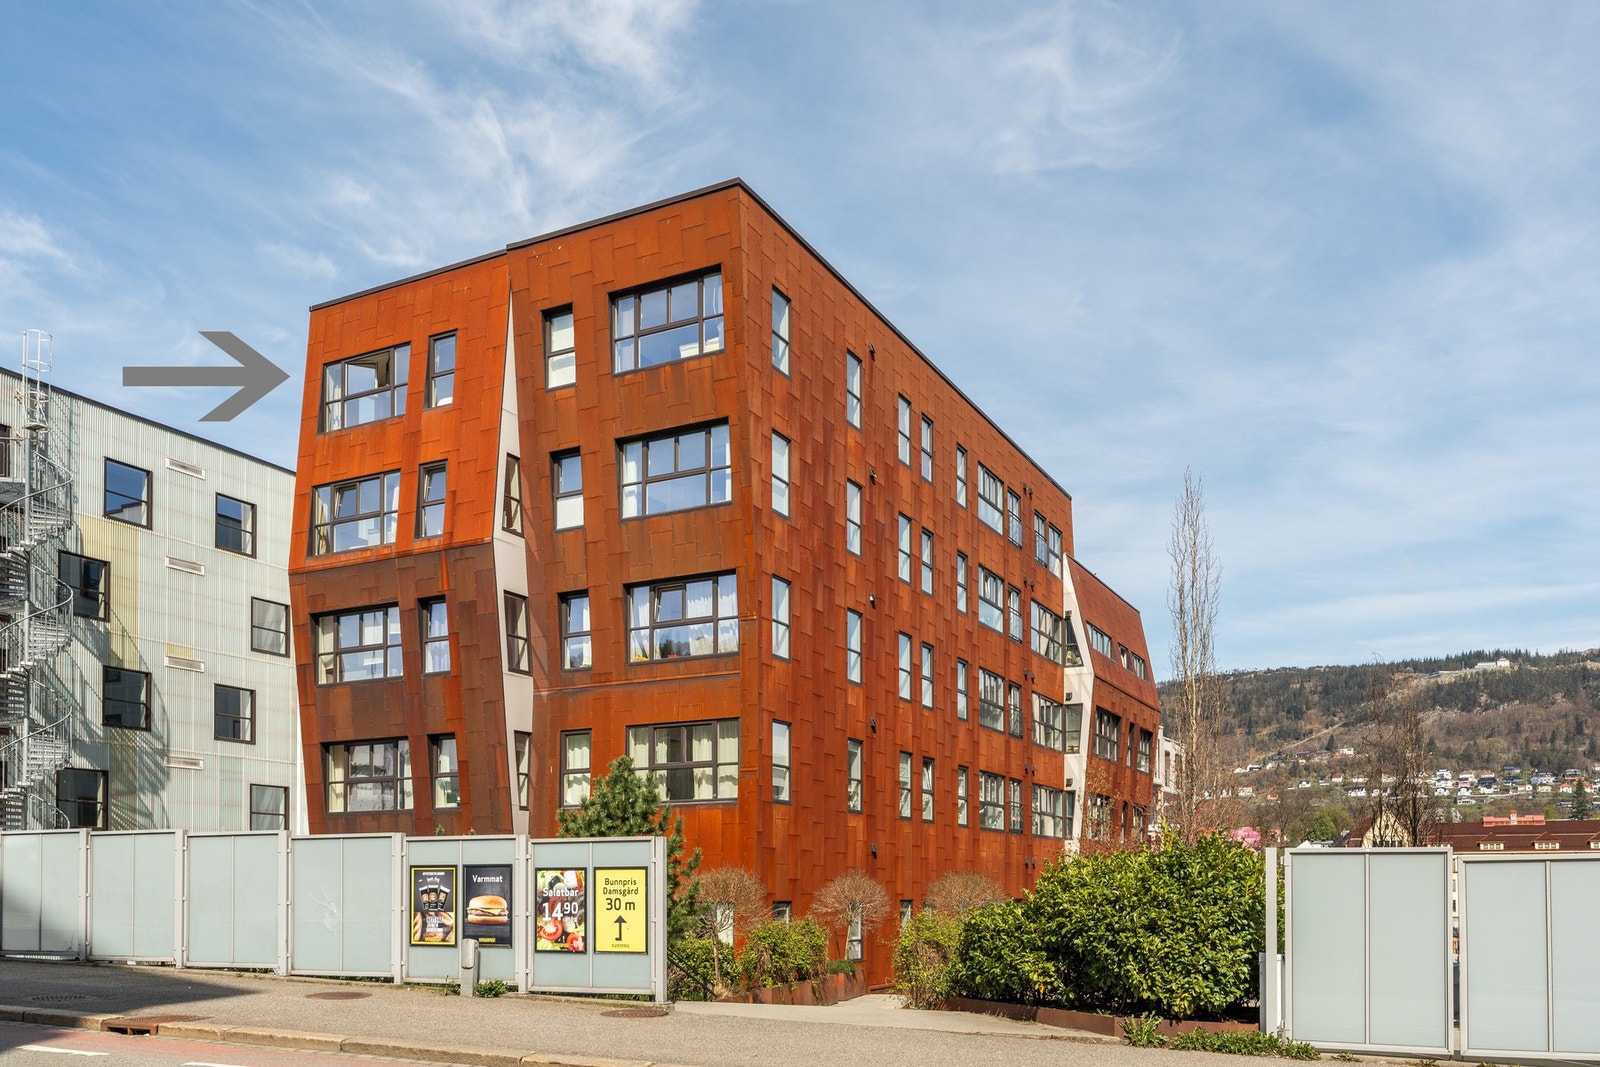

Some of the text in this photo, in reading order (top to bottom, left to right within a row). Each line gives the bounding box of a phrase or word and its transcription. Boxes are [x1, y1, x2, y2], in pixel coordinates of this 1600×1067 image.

[472, 874, 503, 883] Varmmat
[604, 878, 637, 887] Bunnpris
[543, 887, 579, 897] Salatbar
[603, 887, 639, 897] Damsgård
[605, 897, 636, 911] 30 m
